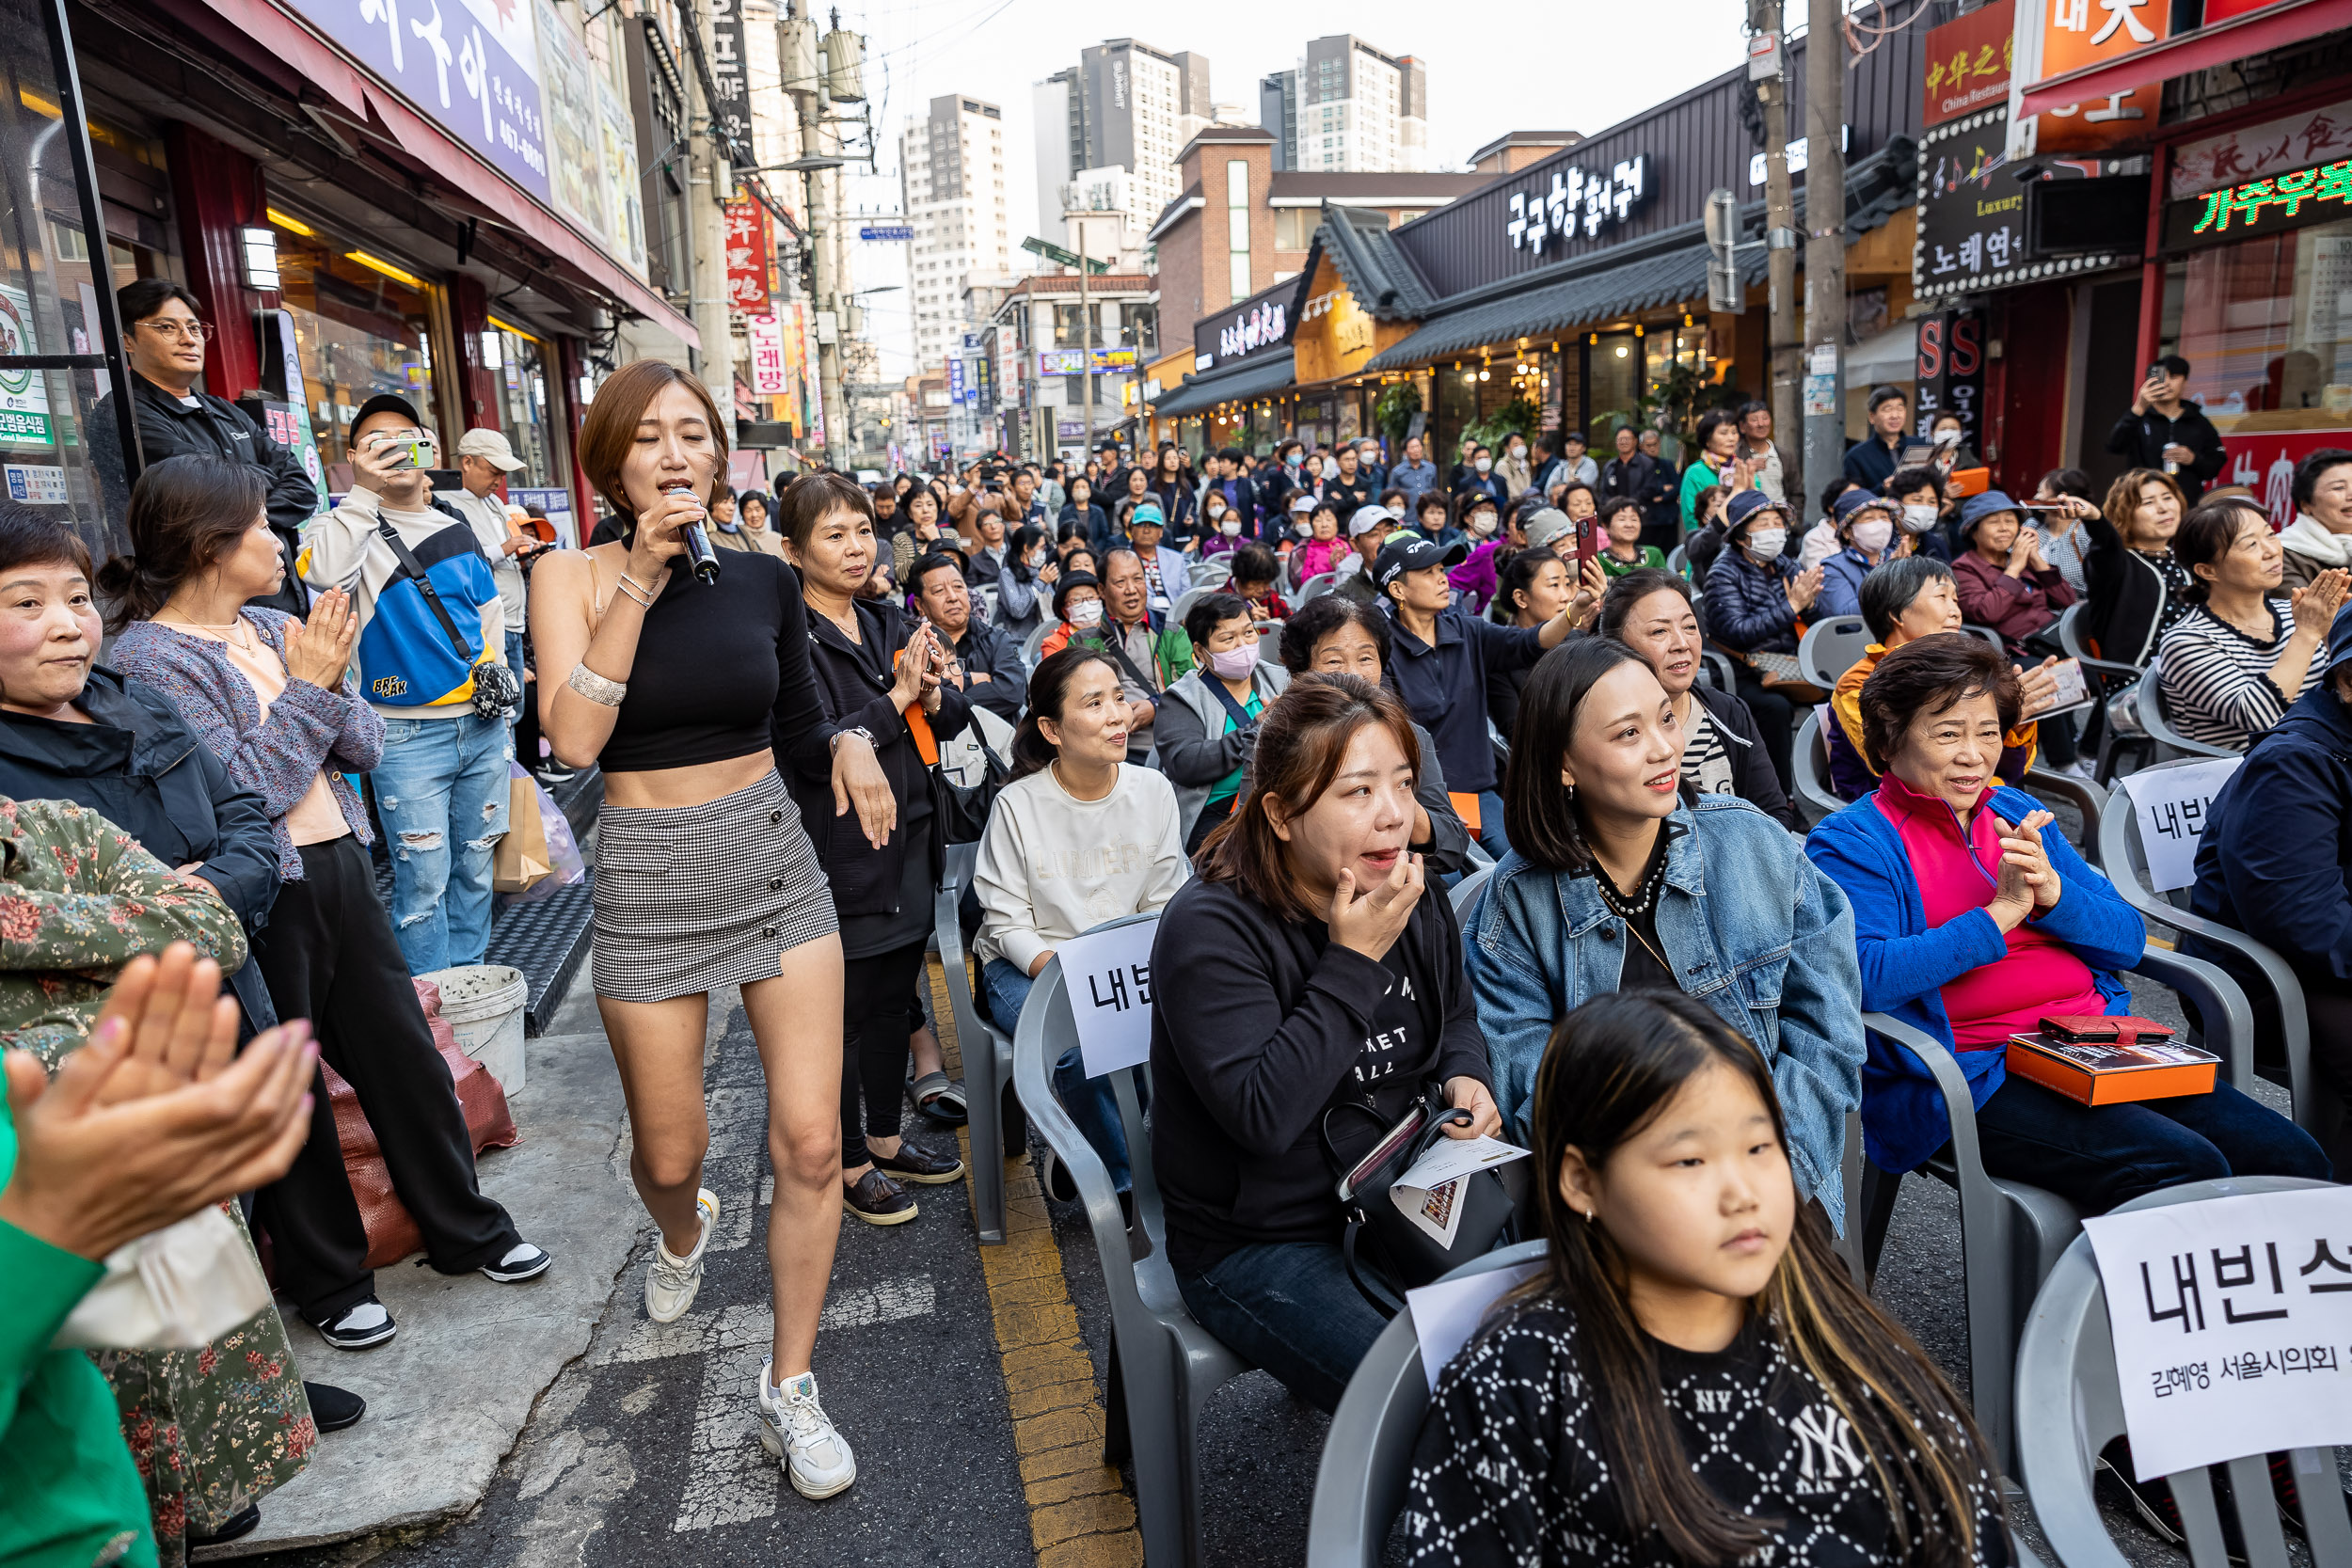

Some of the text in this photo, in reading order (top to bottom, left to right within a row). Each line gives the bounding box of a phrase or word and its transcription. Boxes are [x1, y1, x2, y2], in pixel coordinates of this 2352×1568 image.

[1942, 93, 1970, 113] China
[1507, 155, 1644, 255] 구구향훠궈
[2151, 1361, 2211, 1398] 김혜영
[2219, 1345, 2339, 1382] 서울시의회
[1693, 1389, 1733, 1413] NY
[1789, 1404, 1865, 1480] NY
